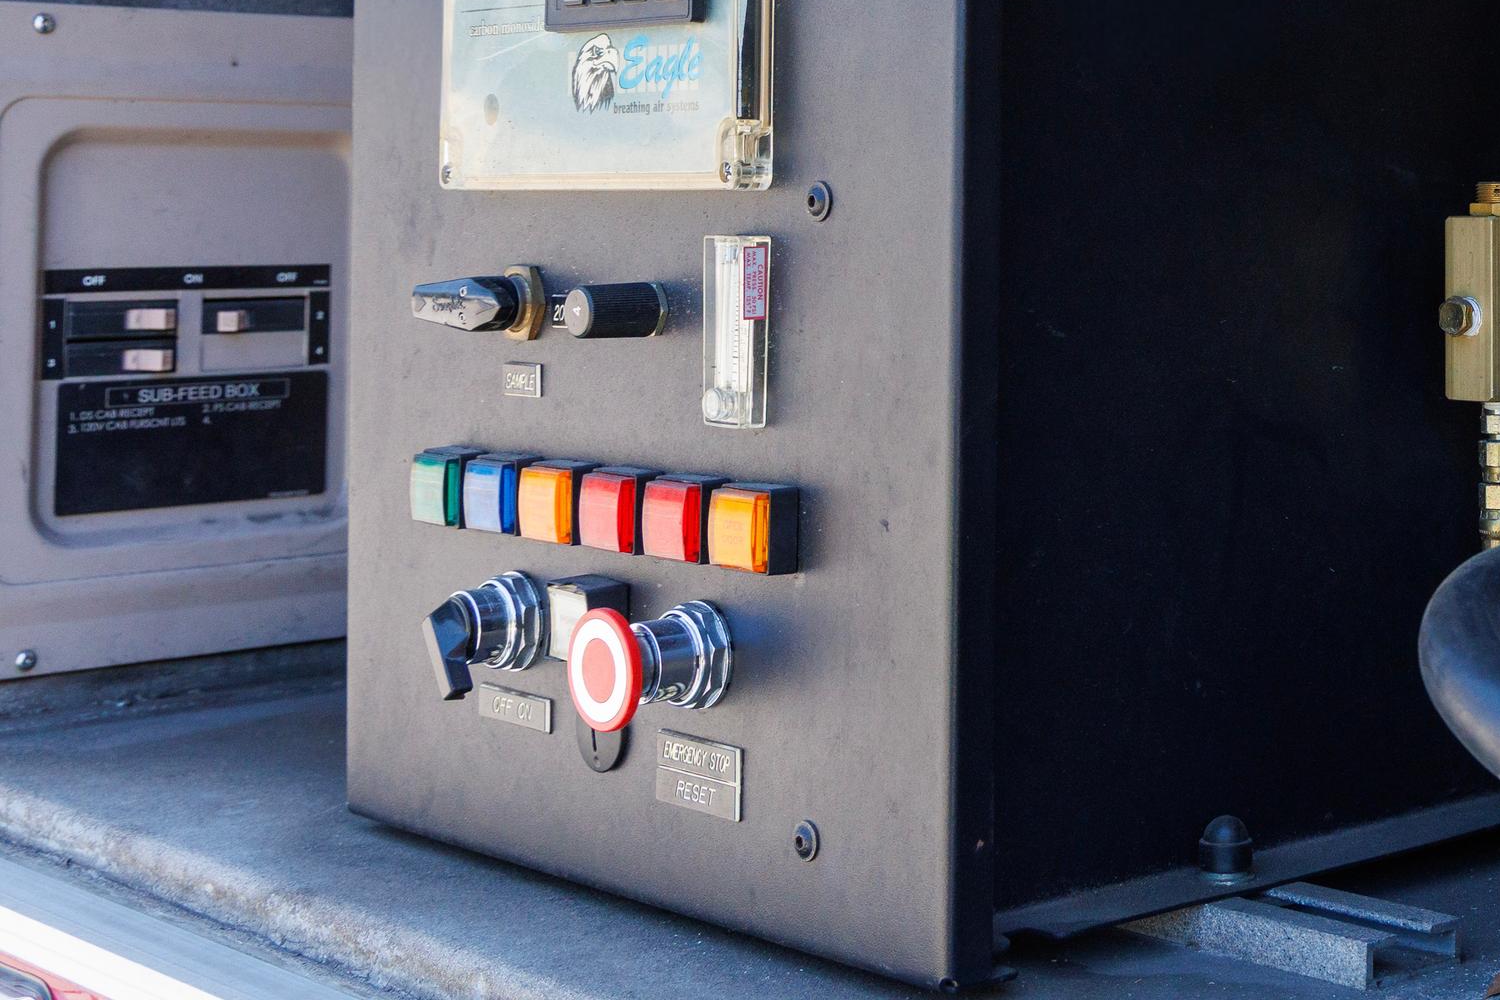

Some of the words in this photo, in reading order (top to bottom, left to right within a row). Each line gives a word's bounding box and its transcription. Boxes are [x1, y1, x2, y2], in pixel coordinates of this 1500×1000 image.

[618, 32, 705, 100] Eagle
[613, 101, 650, 115] breathing
[653, 102, 665, 112] air
[665, 101, 700, 115] systems
[81, 274, 108, 287] OFF
[183, 273, 204, 284] ON
[276, 271, 299, 283] OFF
[505, 372, 536, 391] SAMPLE
[137, 384, 222, 403] SUB-FEED
[225, 383, 260, 399] BOX
[491, 696, 514, 716] OFF
[517, 702, 533, 721] ON
[663, 740, 706, 767] EMERGENCY
[708, 751, 731, 773] STOP
[675, 780, 716, 806] RESET
